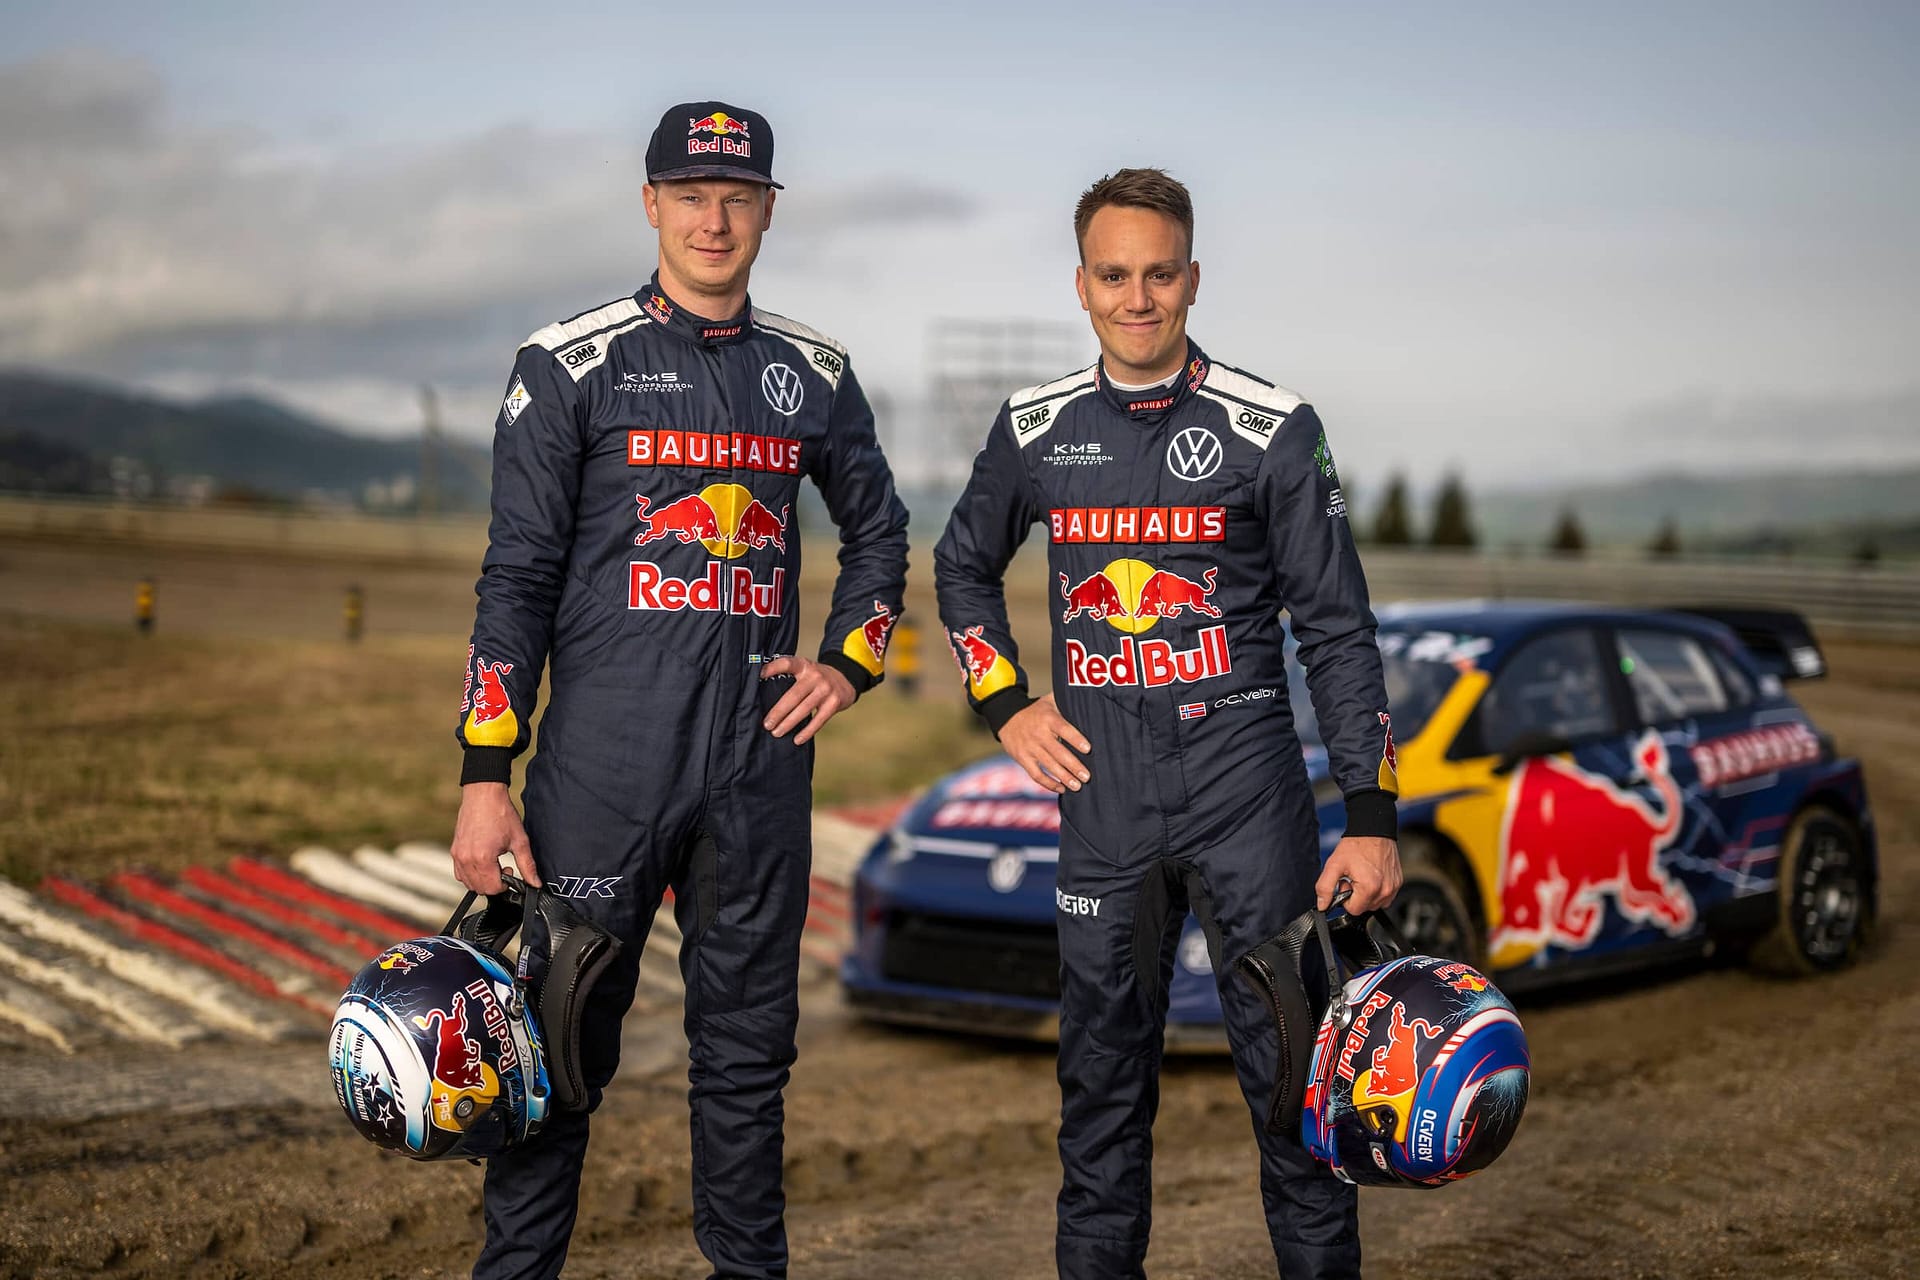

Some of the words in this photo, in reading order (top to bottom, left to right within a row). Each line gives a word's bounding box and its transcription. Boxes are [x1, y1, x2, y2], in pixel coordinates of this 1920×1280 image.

[688, 136, 719, 154] Red
[723, 138, 750, 158] Bull
[704, 327, 742, 338] BAUHAUS
[565, 345, 597, 365] OMP
[813, 351, 841, 373] OMP
[624, 372, 678, 382] KMS
[1130, 397, 1175, 411] BAUHAUS
[1018, 408, 1050, 430] OMP
[1239, 412, 1274, 432] OMP
[631, 433, 800, 471] BAUHAUS
[1054, 443, 1101, 454] KMS
[1050, 510, 1224, 540] BAUHAUS
[628, 561, 721, 611] Red
[730, 566, 785, 617] Bull
[1066, 636, 1139, 687] Red
[1139, 625, 1232, 688] Bull
[547, 876, 624, 899] JK
[465, 978, 505, 1029] Bull
[1352, 990, 1393, 1037] Red
[353, 1031, 366, 1075] SECUNDIS
[488, 1020, 518, 1075] Red
[1337, 1031, 1366, 1081] Bull
[1375, 1150, 1385, 1168] BELL
